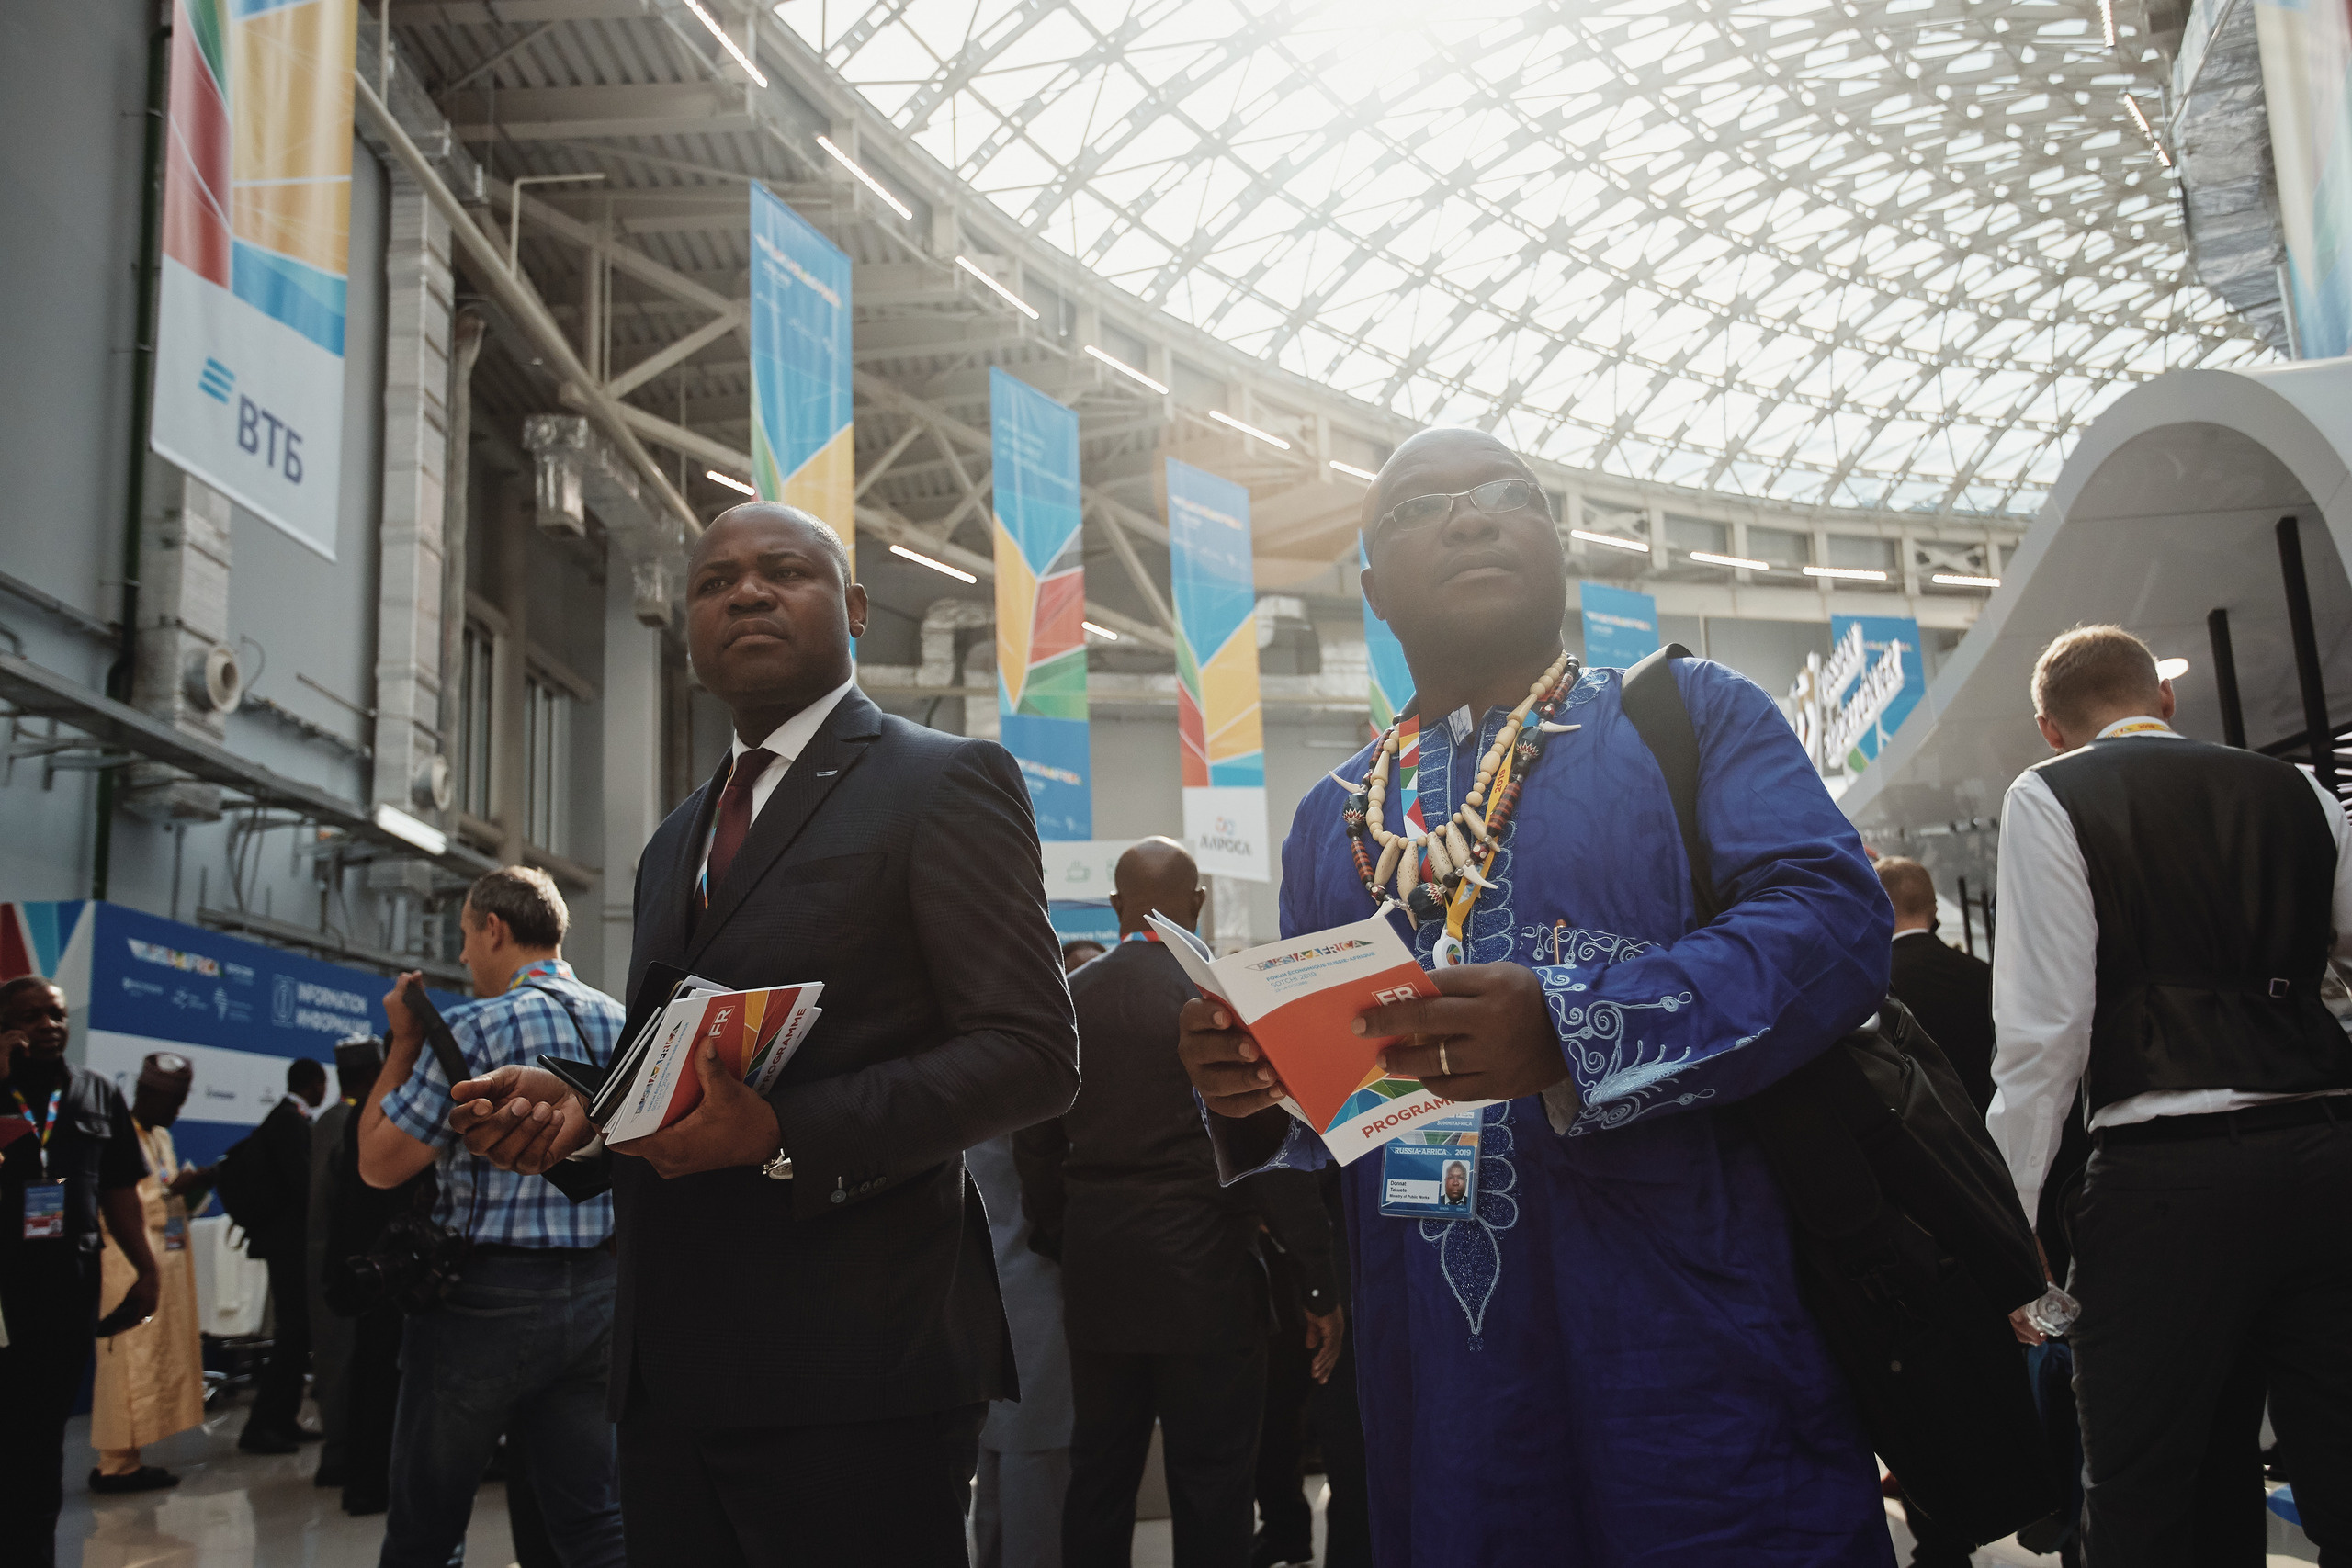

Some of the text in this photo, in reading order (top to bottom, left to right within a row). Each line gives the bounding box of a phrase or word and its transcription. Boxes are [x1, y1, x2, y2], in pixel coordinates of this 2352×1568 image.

[238, 393, 303, 485] ВТБ
[1494, 769, 1506, 794] 2019
[1266, 972, 1287, 982] FORUM
[1270, 971, 1317, 988] SOTCHI 2019
[707, 1008, 733, 1037] FR
[758, 1008, 807, 1091] PROGRAMME
[1361, 1098, 1455, 1139] PROGRAM
